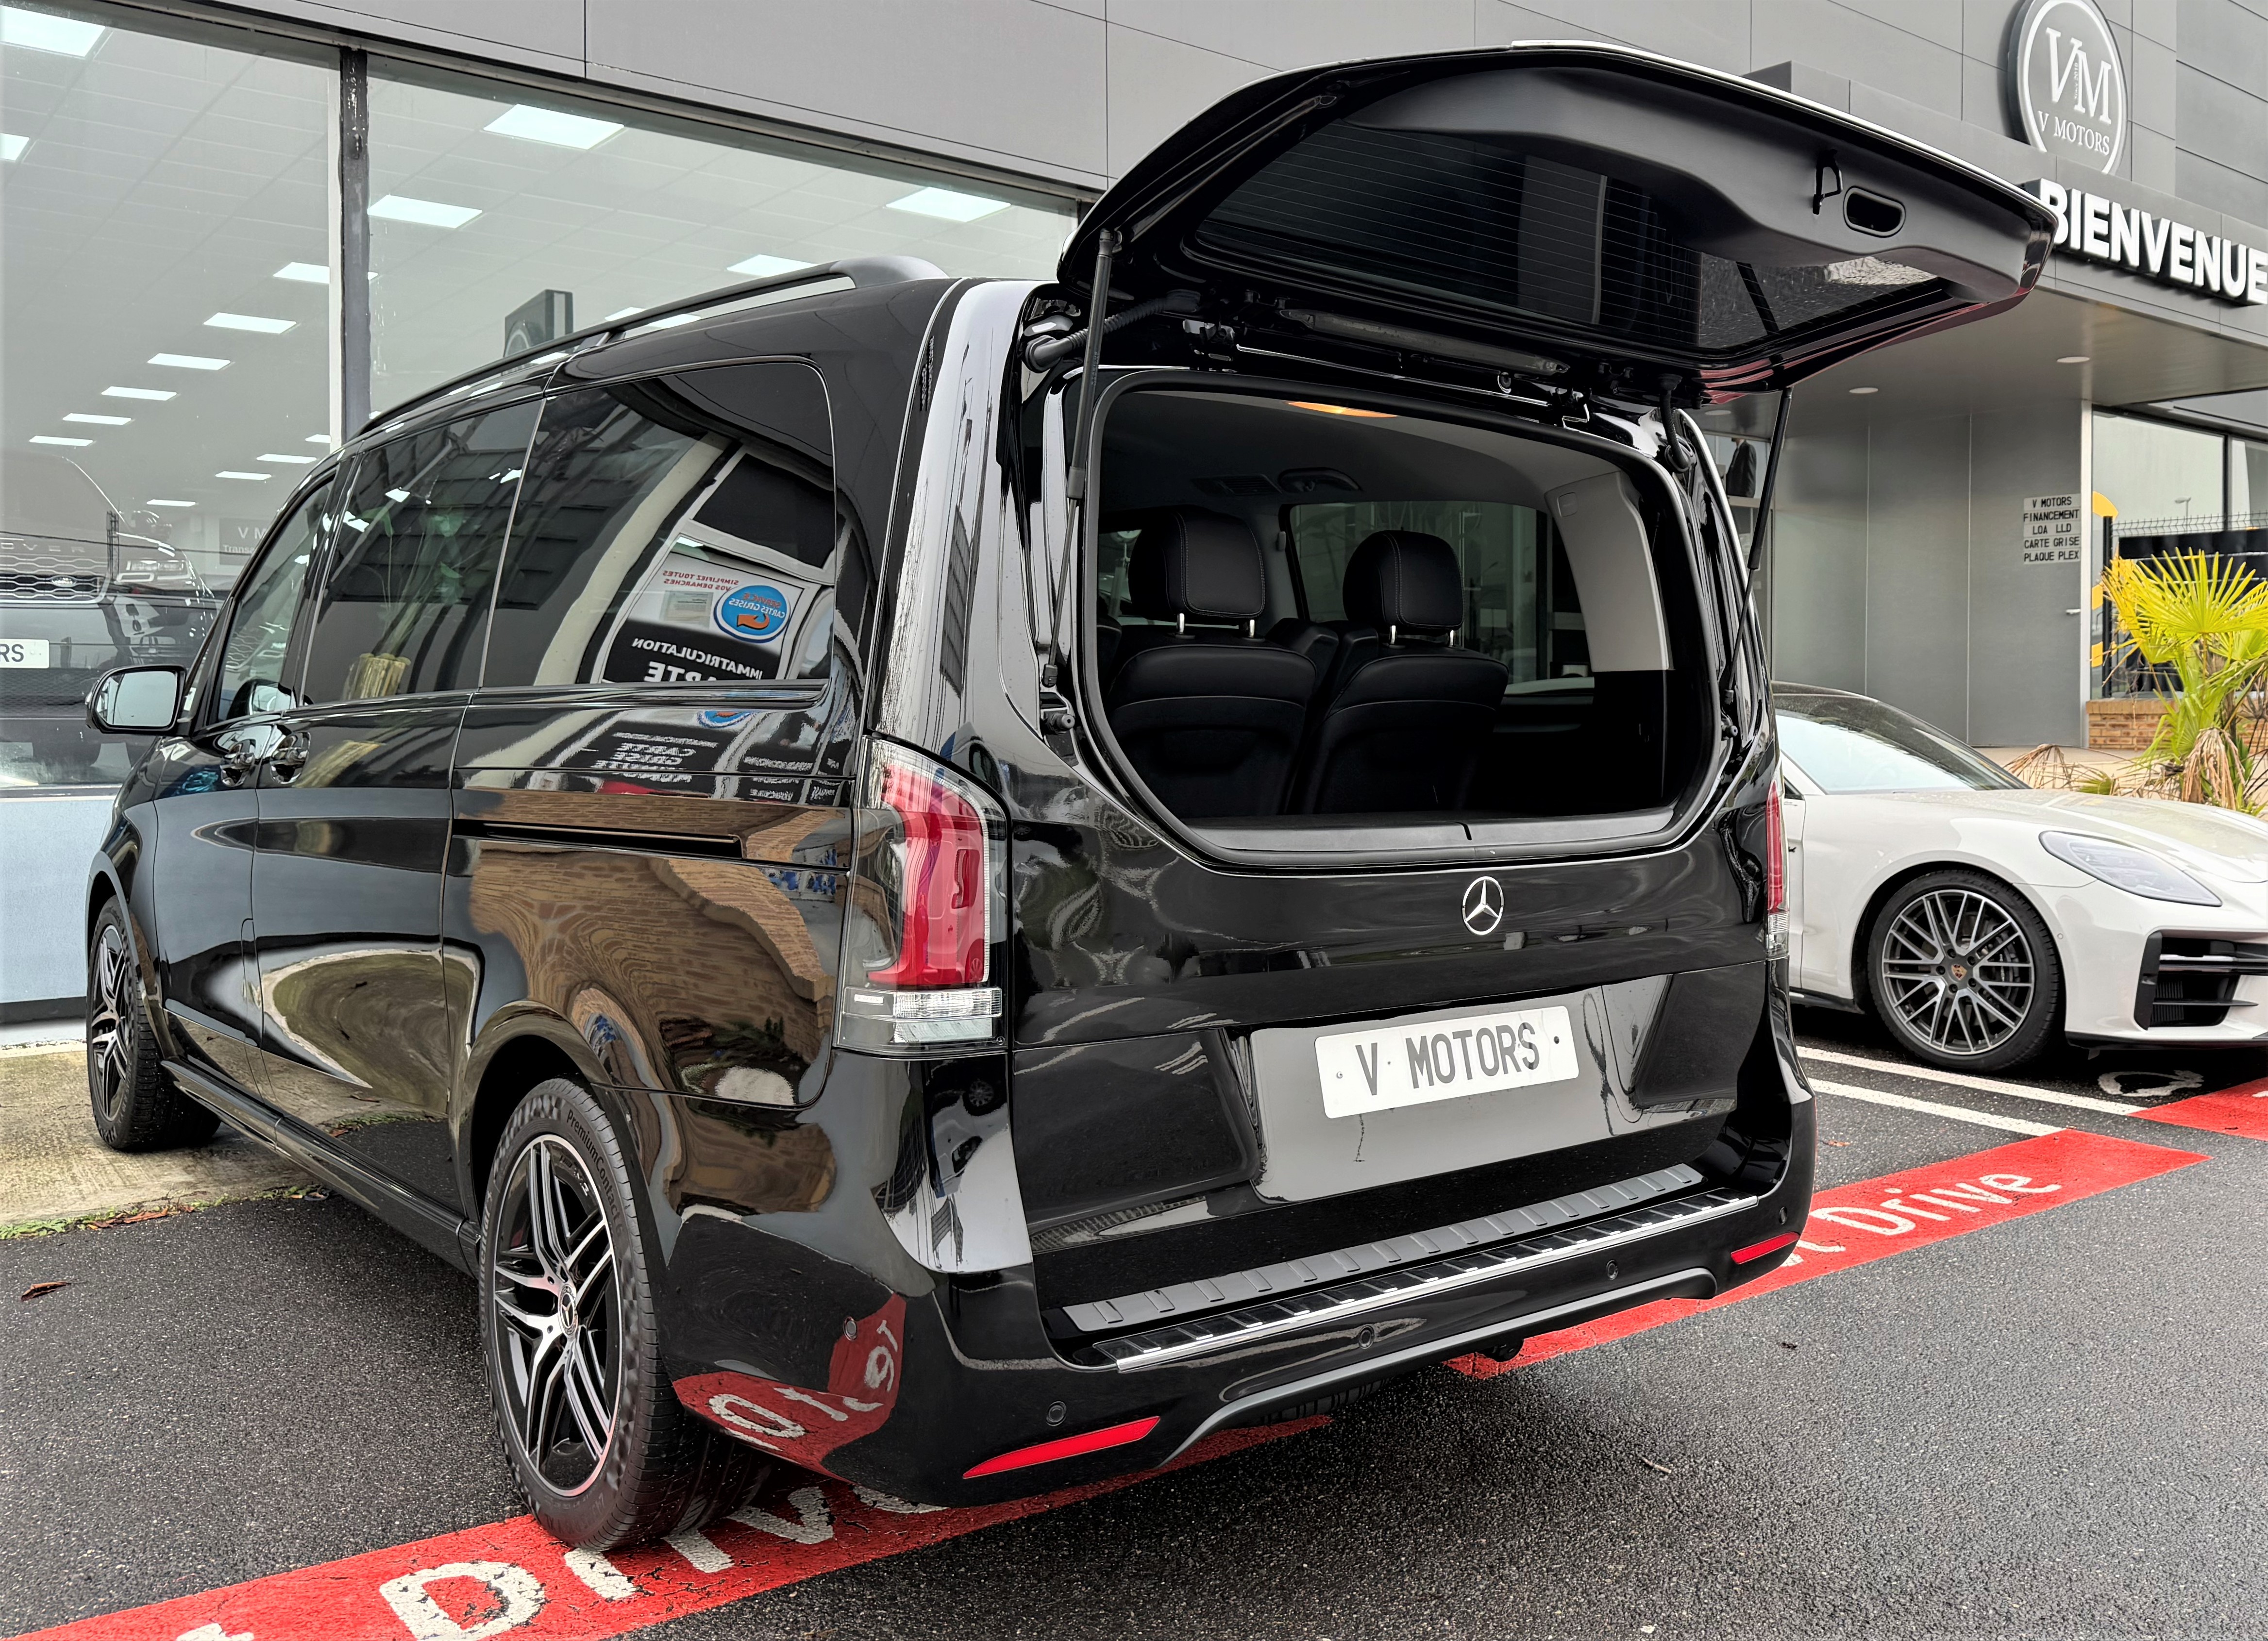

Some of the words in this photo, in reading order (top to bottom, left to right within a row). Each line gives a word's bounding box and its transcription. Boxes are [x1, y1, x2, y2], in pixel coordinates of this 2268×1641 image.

[2046, 27, 2112, 124] VM
[2038, 111, 2050, 132] V
[2053, 117, 2109, 155] MOTORS
[2041, 178, 2268, 304] BIENVENUE
[2023, 509, 2080, 522] FINANCEMENT
[2033, 499, 2037, 508] V
[2041, 496, 2072, 507] MOTORS
[238, 526, 248, 539] V
[2024, 538, 2050, 548] CARTE
[2053, 536, 2080, 547] GRISE
[2033, 525, 2048, 535] LOA
[2056, 523, 2071, 533] LLD
[2024, 552, 2054, 562] PLAQUE
[2058, 550, 2079, 560] PLEX
[1355, 1042, 1378, 1096] V
[1406, 1022, 1540, 1089] MOTORS
[567, 1109, 620, 1221] PremiumContact
[1809, 1173, 2062, 1235] Drive
